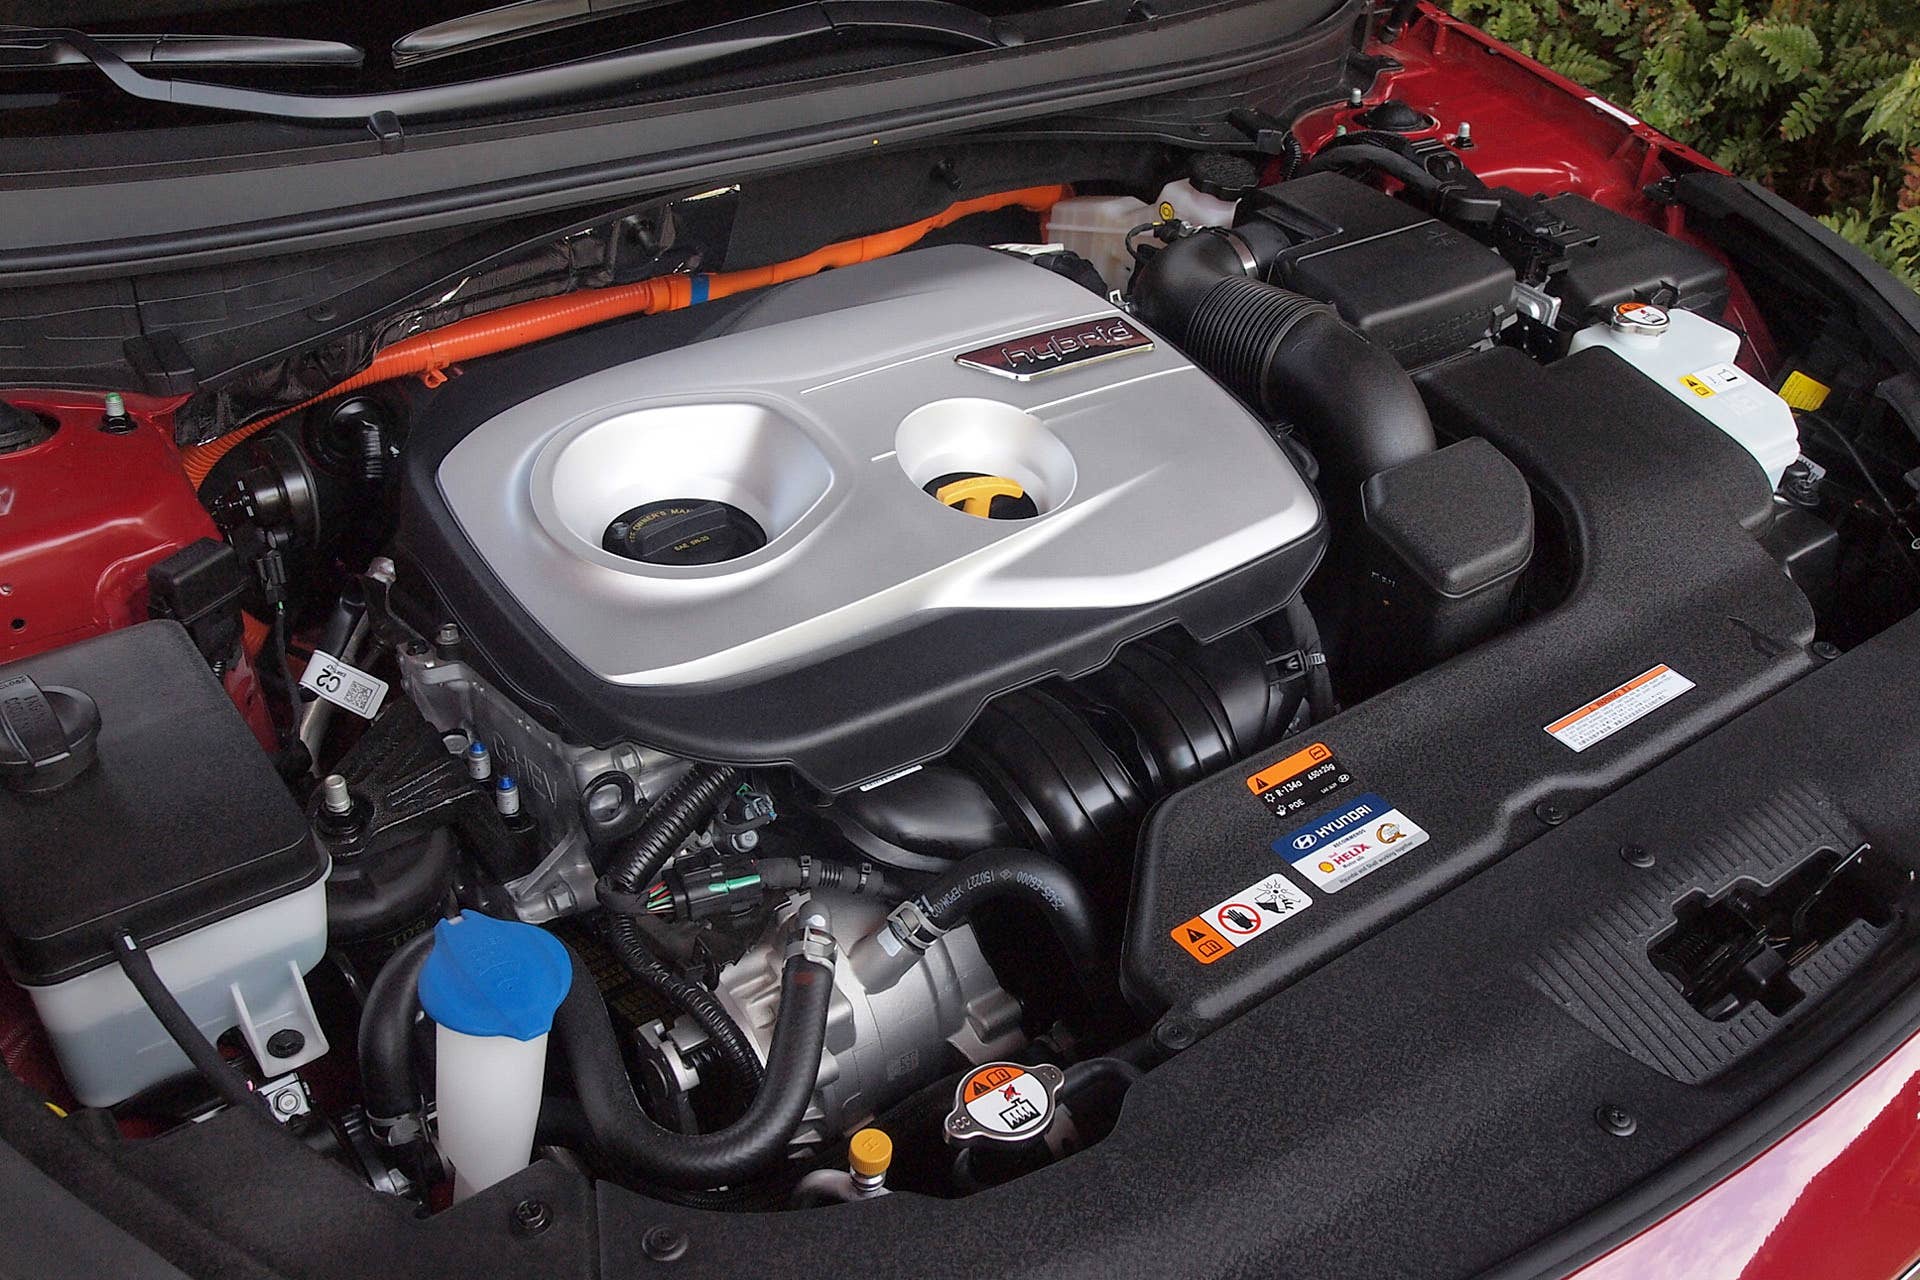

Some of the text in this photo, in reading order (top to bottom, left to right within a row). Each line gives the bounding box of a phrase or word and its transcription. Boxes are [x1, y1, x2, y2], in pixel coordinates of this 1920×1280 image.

[1002, 320, 1133, 367] hybrid
[316, 668, 341, 693] C2
[1275, 780, 1303, 798] R-134a
[1288, 799, 1306, 811] POE
[1315, 804, 1373, 838] HYUNDAI
[1333, 829, 1367, 849] RECOMMENDS
[1333, 843, 1370, 865] HELIX
